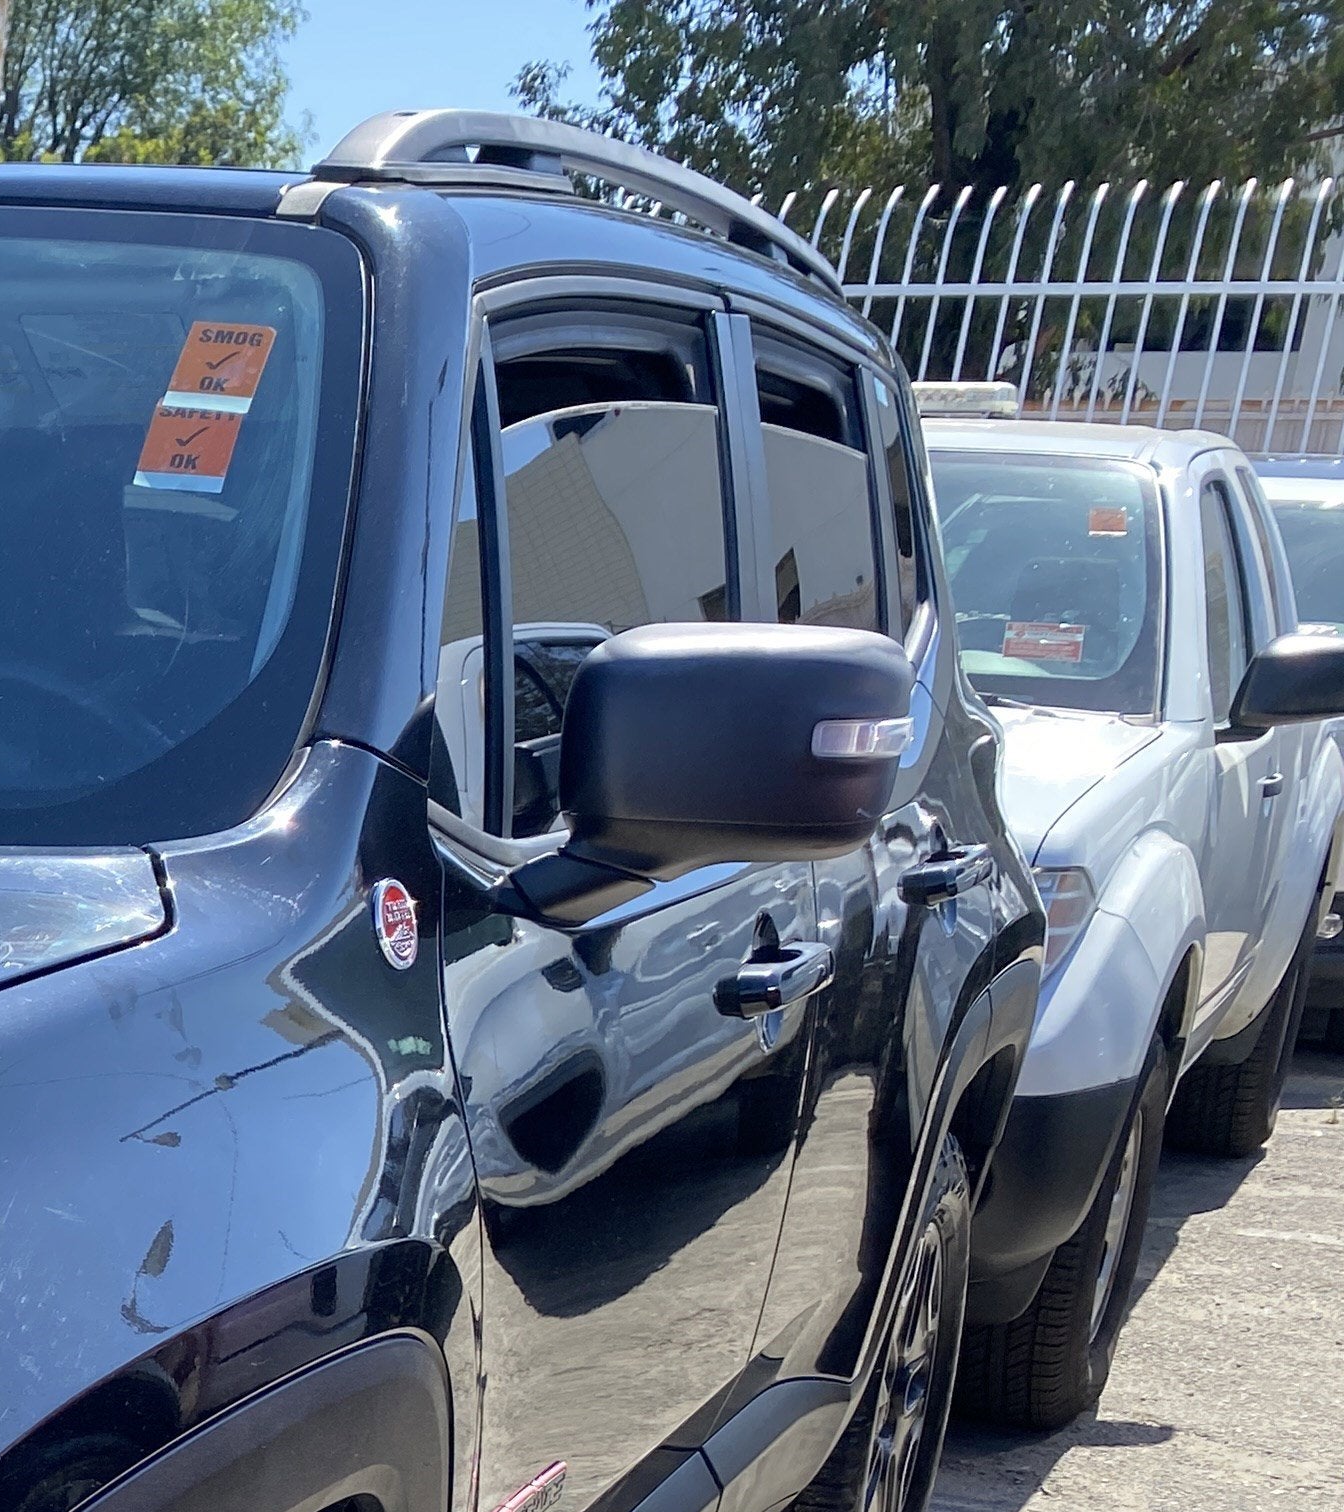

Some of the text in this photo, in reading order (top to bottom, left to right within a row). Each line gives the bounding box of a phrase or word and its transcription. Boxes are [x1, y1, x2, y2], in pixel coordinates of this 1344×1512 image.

[199, 328, 263, 346] SMOG
[199, 376, 228, 392] OK
[170, 453, 200, 470] OK
